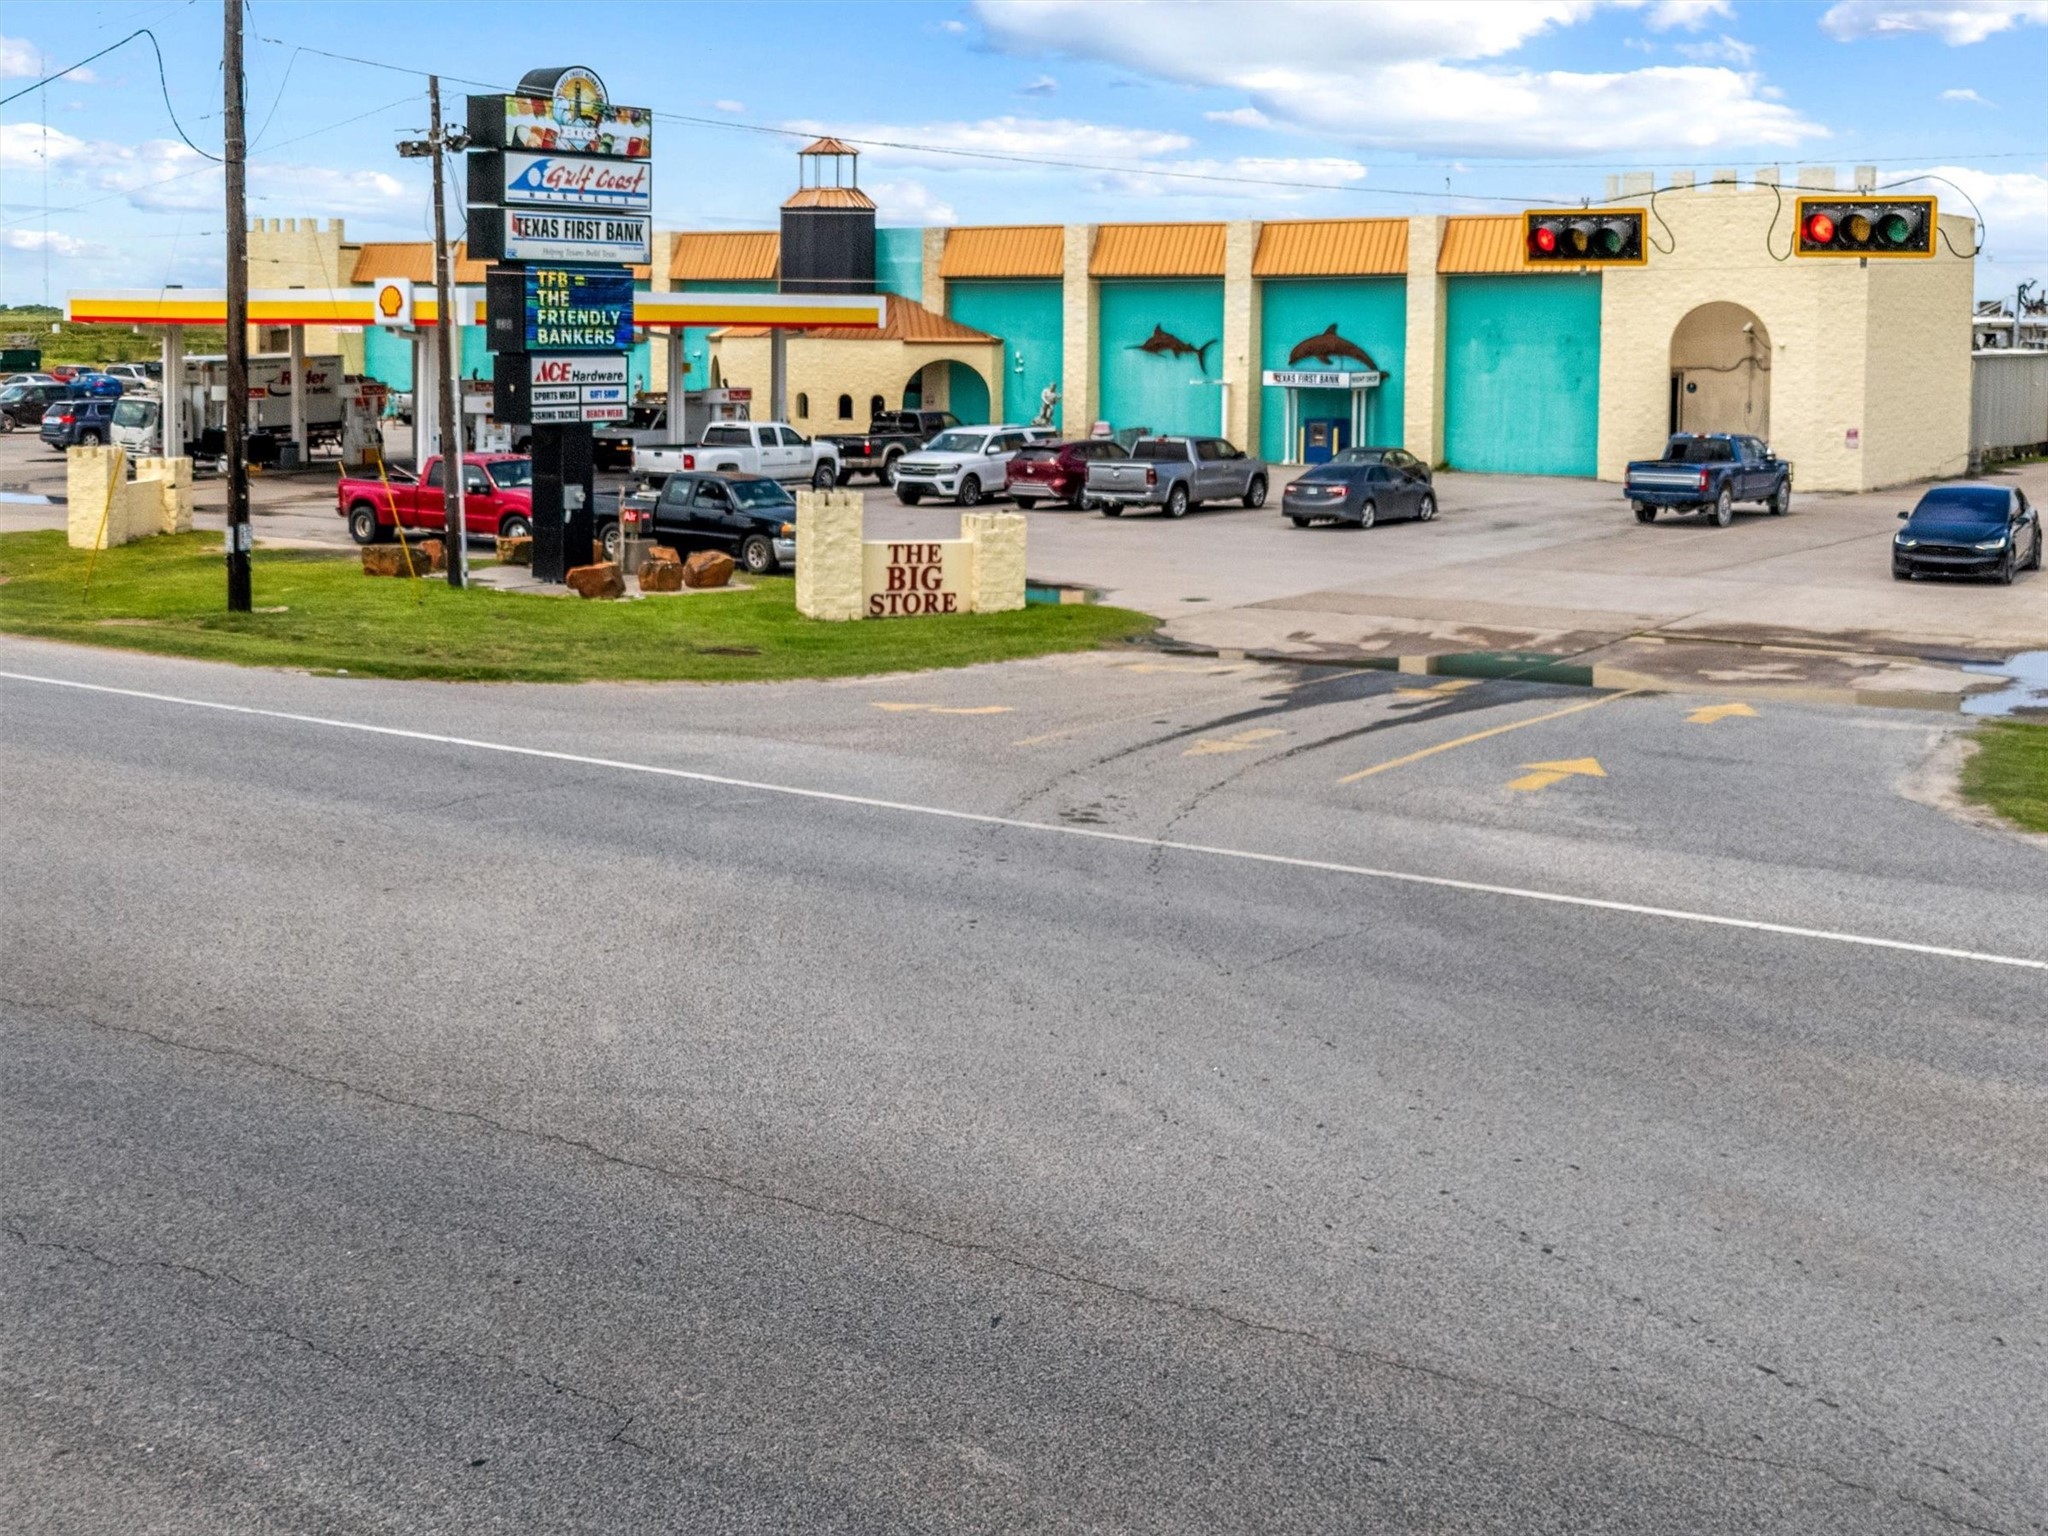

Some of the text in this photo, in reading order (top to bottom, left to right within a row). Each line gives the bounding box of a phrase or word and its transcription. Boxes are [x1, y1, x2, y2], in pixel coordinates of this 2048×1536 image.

[546, 164, 645, 194] Gulf Coast
[529, 192, 630, 205] MARKETS
[516, 217, 643, 242] TEXAS FIRST BANK
[536, 271, 568, 287] TFB
[536, 290, 570, 307] THE
[537, 310, 621, 326] FRIENDLY
[537, 329, 616, 345] BANKERS
[535, 361, 624, 382] ACE Hardware
[1298, 374, 1316, 383] FIRST
[1319, 374, 1339, 384] BANK
[534, 390, 577, 401] SPORTS WEAR
[589, 390, 620, 399] GIFT SHOP
[533, 410, 579, 420] FISHING TACKLE
[586, 409, 623, 418] BEACH WEAR
[623, 510, 637, 521] Air
[887, 543, 943, 564] THE
[886, 566, 943, 592] BIG
[870, 592, 958, 615] STORE
